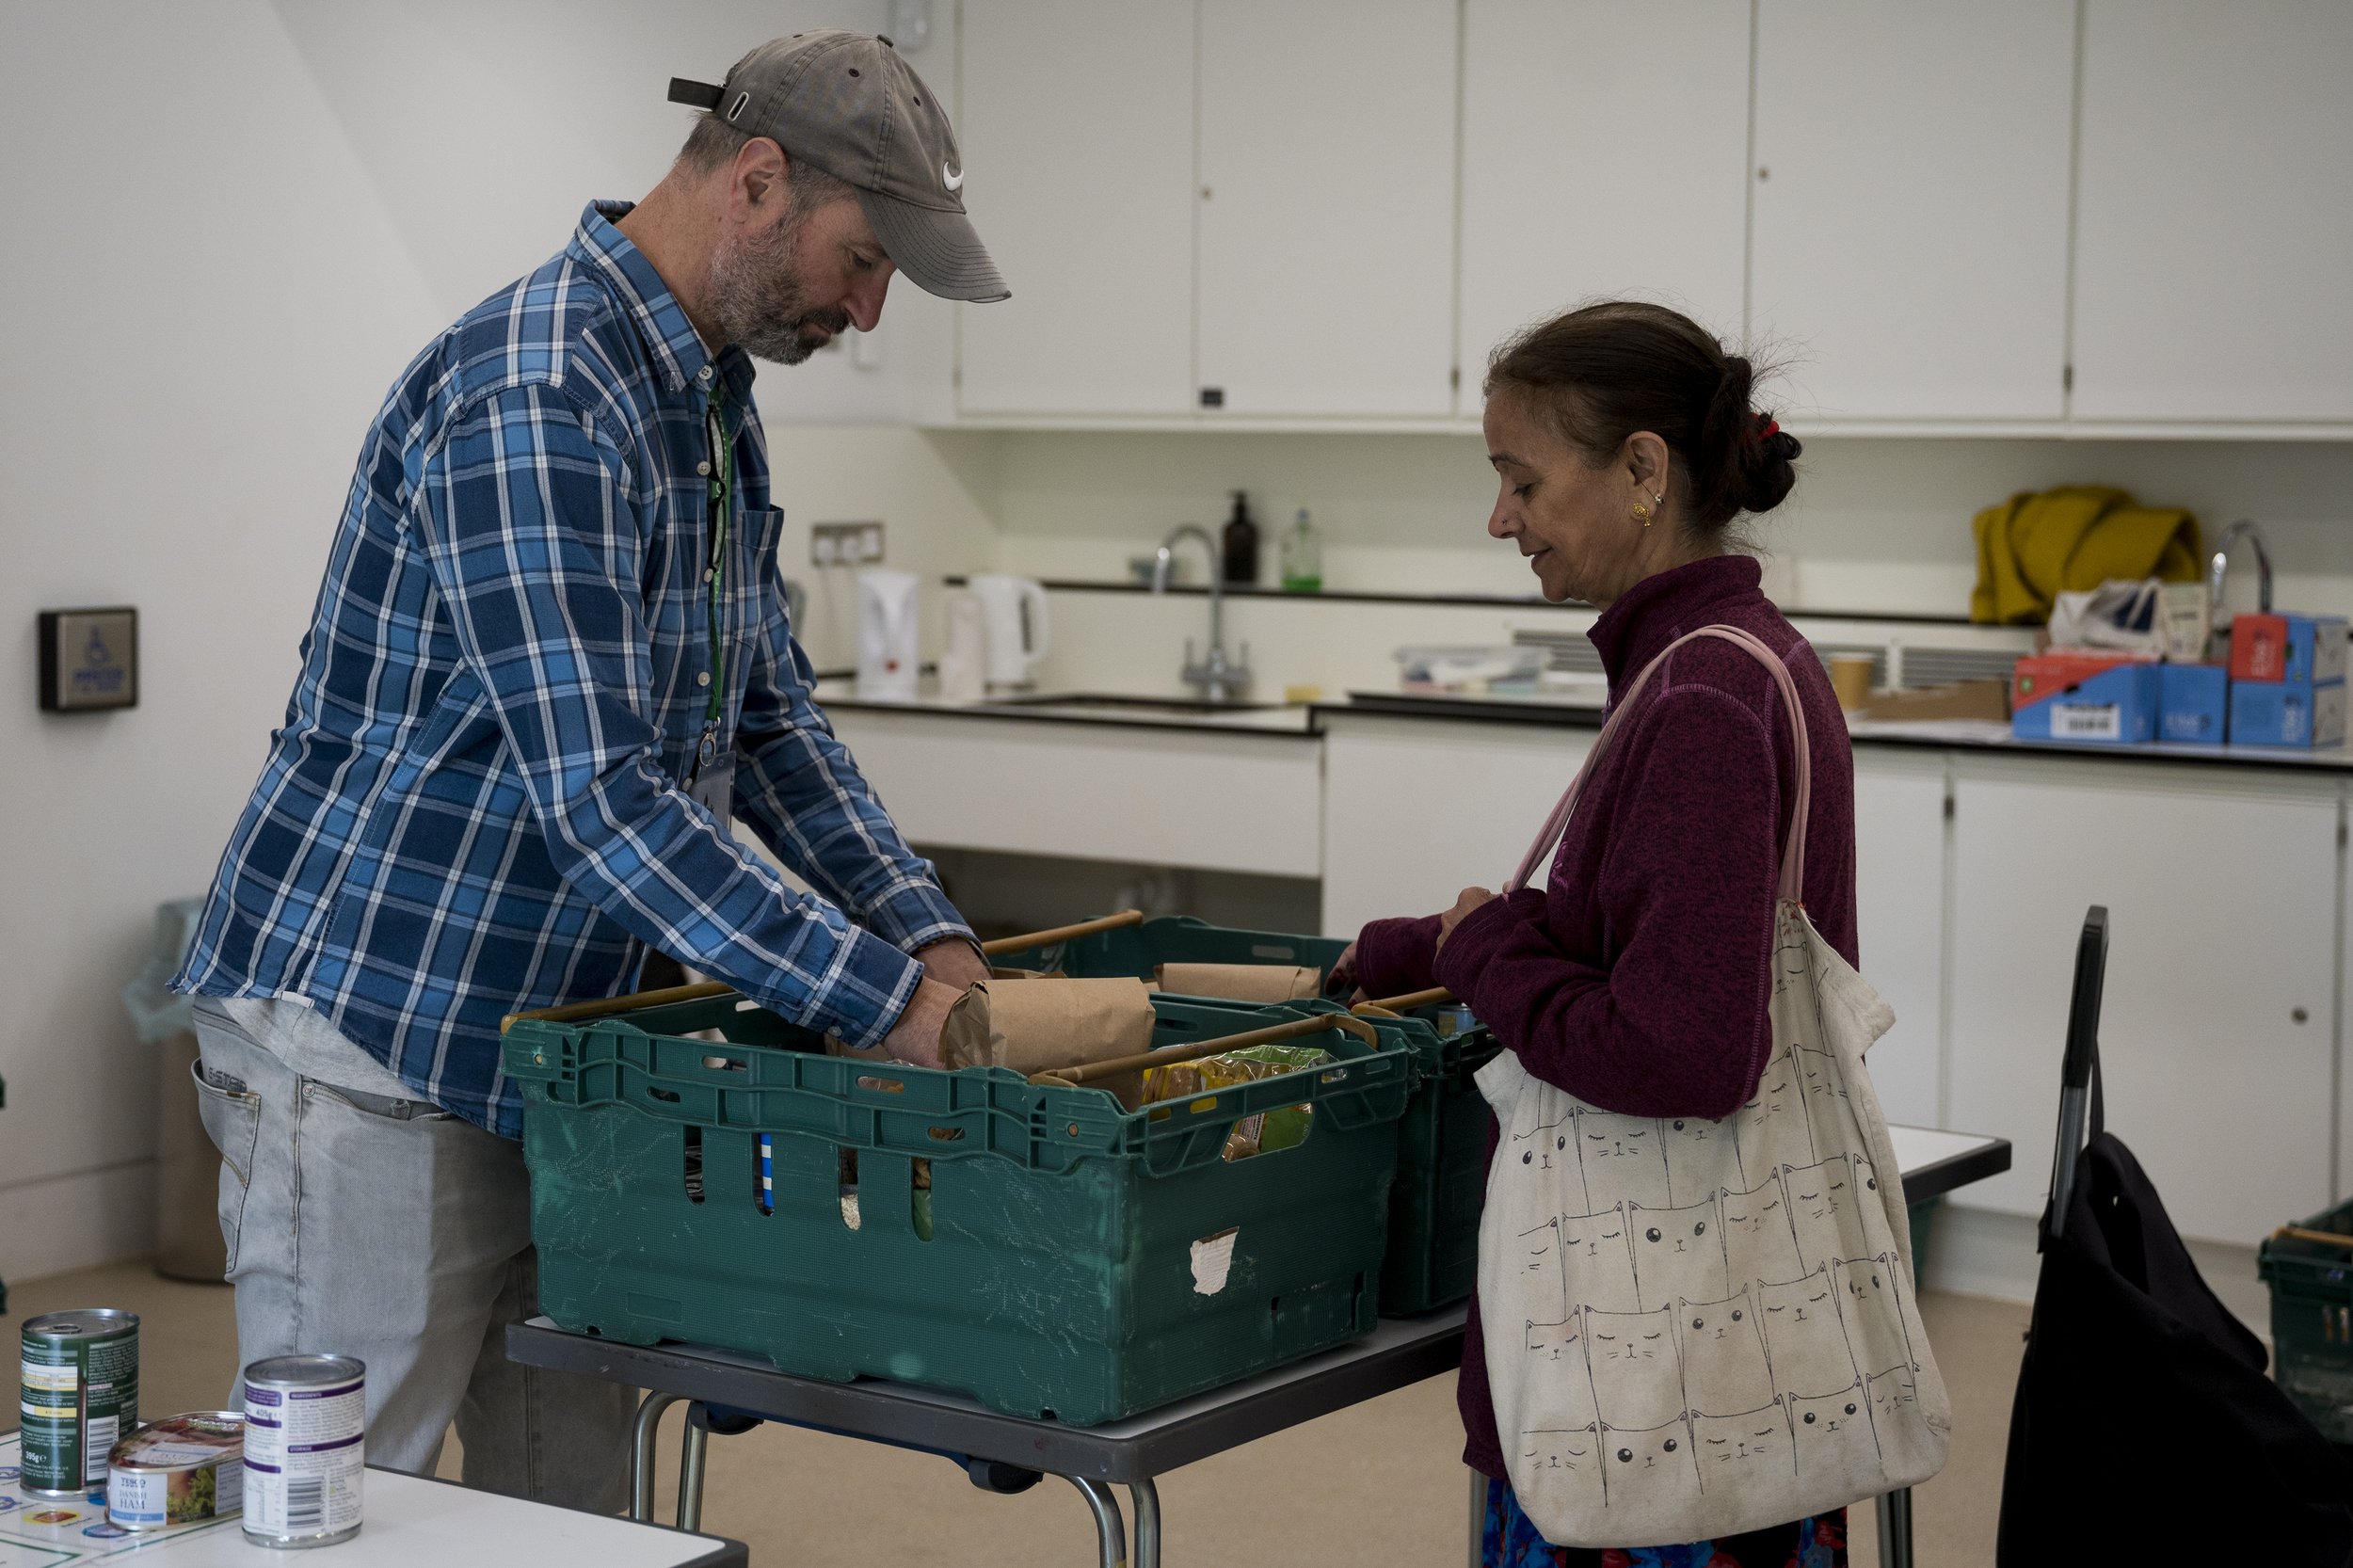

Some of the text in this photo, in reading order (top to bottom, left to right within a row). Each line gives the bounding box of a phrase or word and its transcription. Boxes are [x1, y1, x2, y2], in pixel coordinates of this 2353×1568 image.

[26, 1451, 40, 1464] 395g
[120, 1477, 146, 1486] TESCO
[120, 1490, 146, 1499] DANISH
[120, 1498, 145, 1510] HAM
